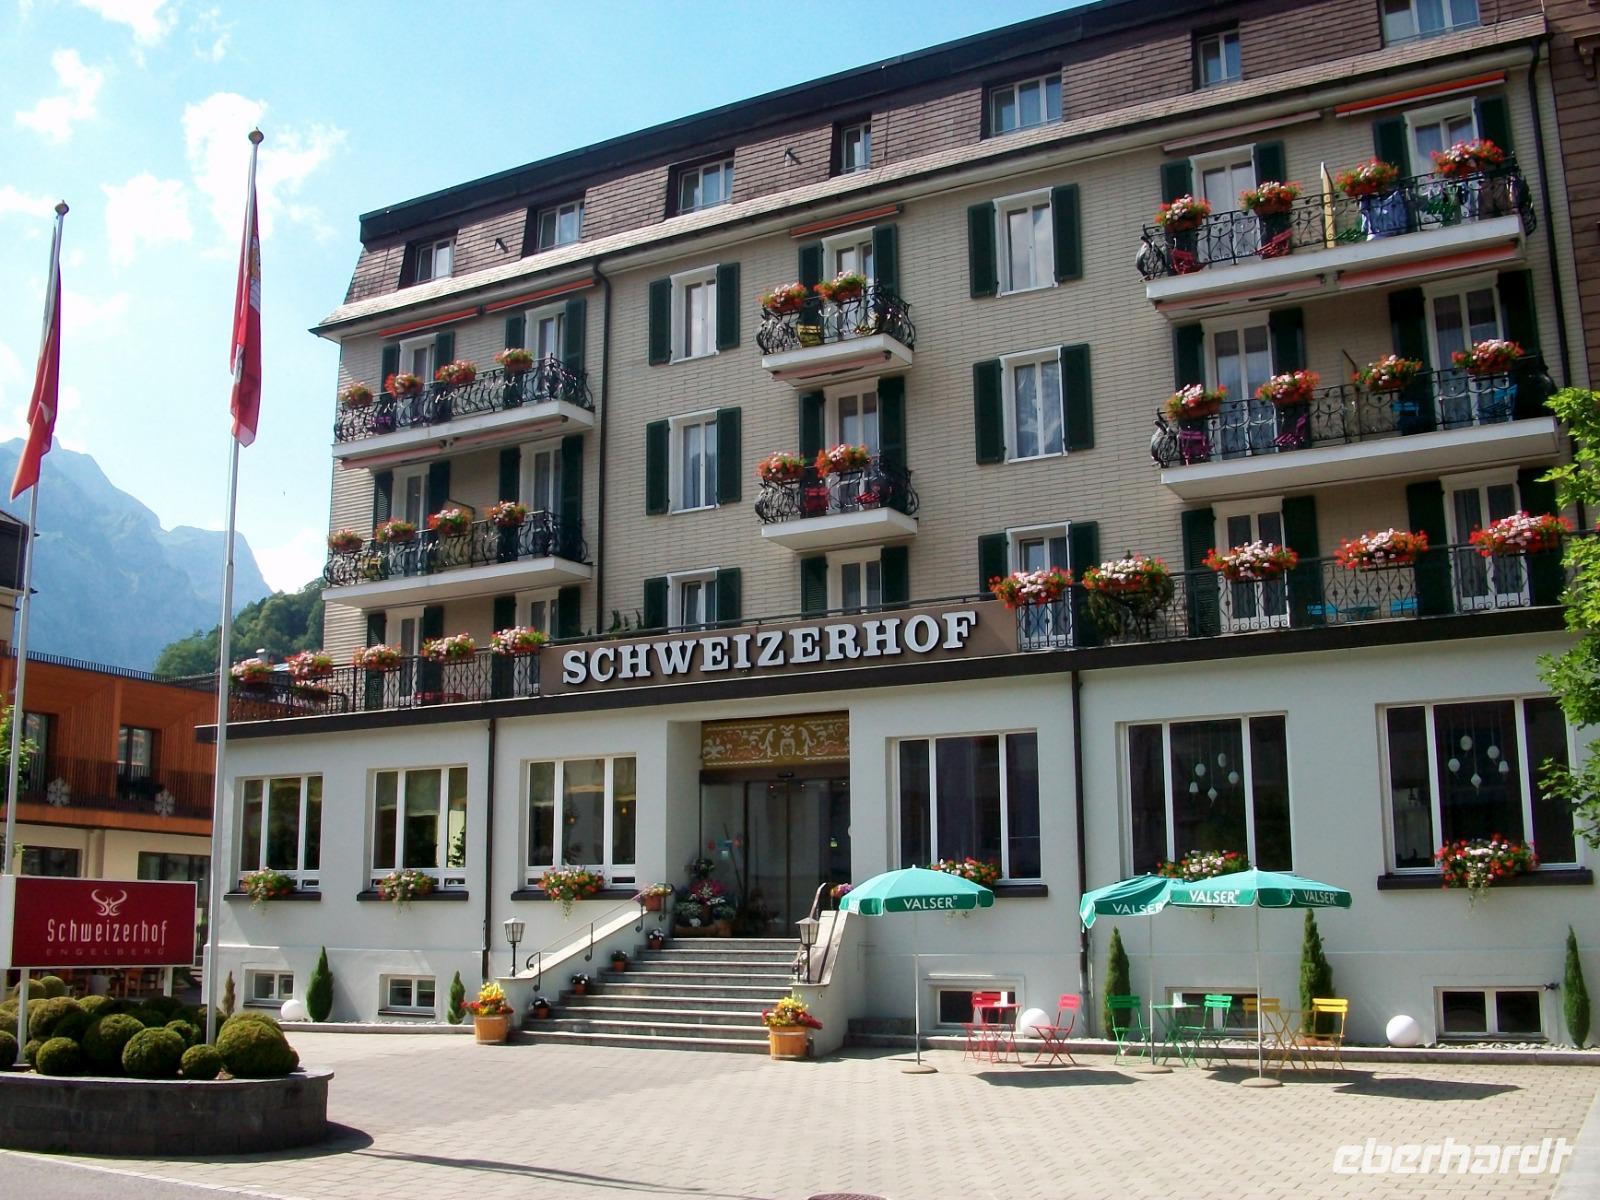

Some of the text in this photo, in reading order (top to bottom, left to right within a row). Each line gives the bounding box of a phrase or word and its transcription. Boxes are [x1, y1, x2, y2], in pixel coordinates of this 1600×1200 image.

[562, 610, 978, 685] SCHWEIZERHOF
[903, 896, 954, 910] VALSER
[1189, 889, 1237, 904] VALSER
[1303, 889, 1337, 904] VALSER
[47, 918, 168, 946] Schweizerhof
